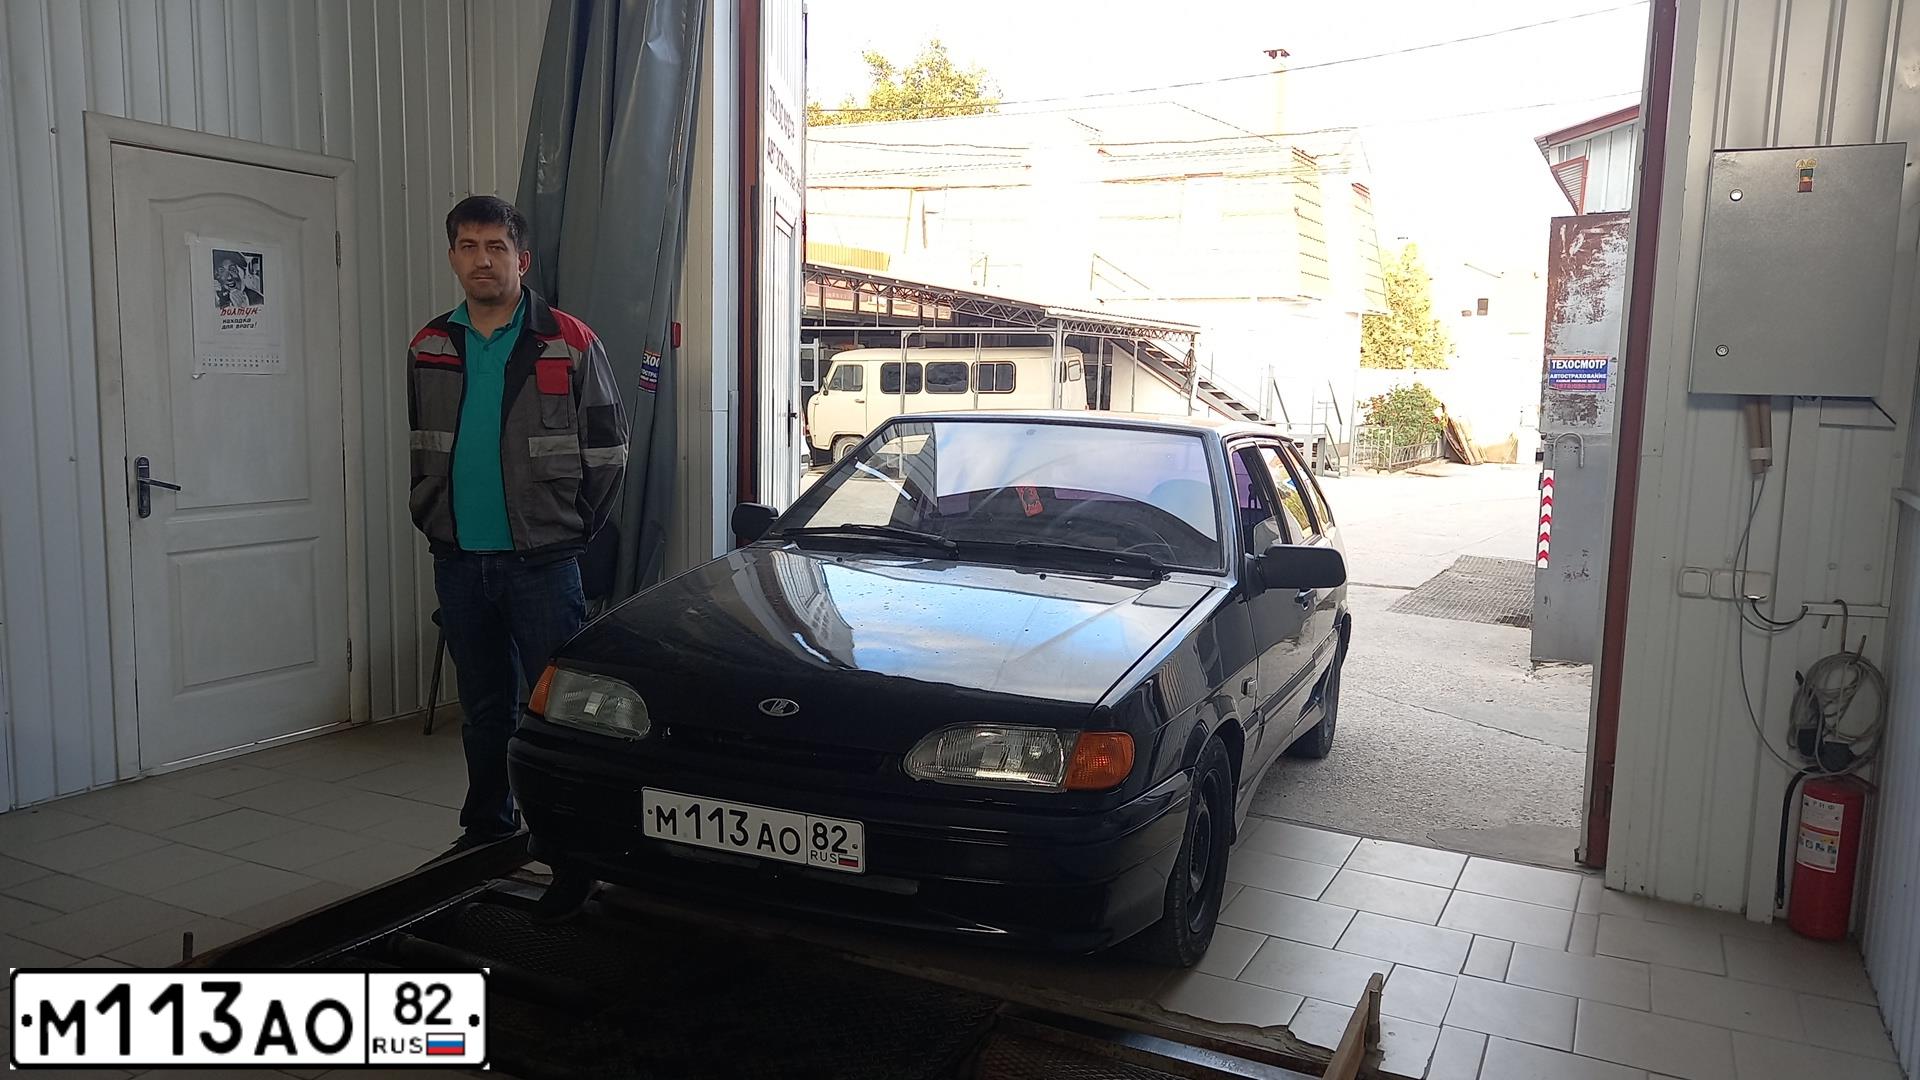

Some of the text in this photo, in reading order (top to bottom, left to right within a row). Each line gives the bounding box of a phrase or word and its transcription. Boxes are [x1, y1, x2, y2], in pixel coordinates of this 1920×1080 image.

[1551, 359, 1607, 370] ТЕХОСМОТР
[811, 822, 848, 854] 82
[810, 850, 838, 864] RUS
